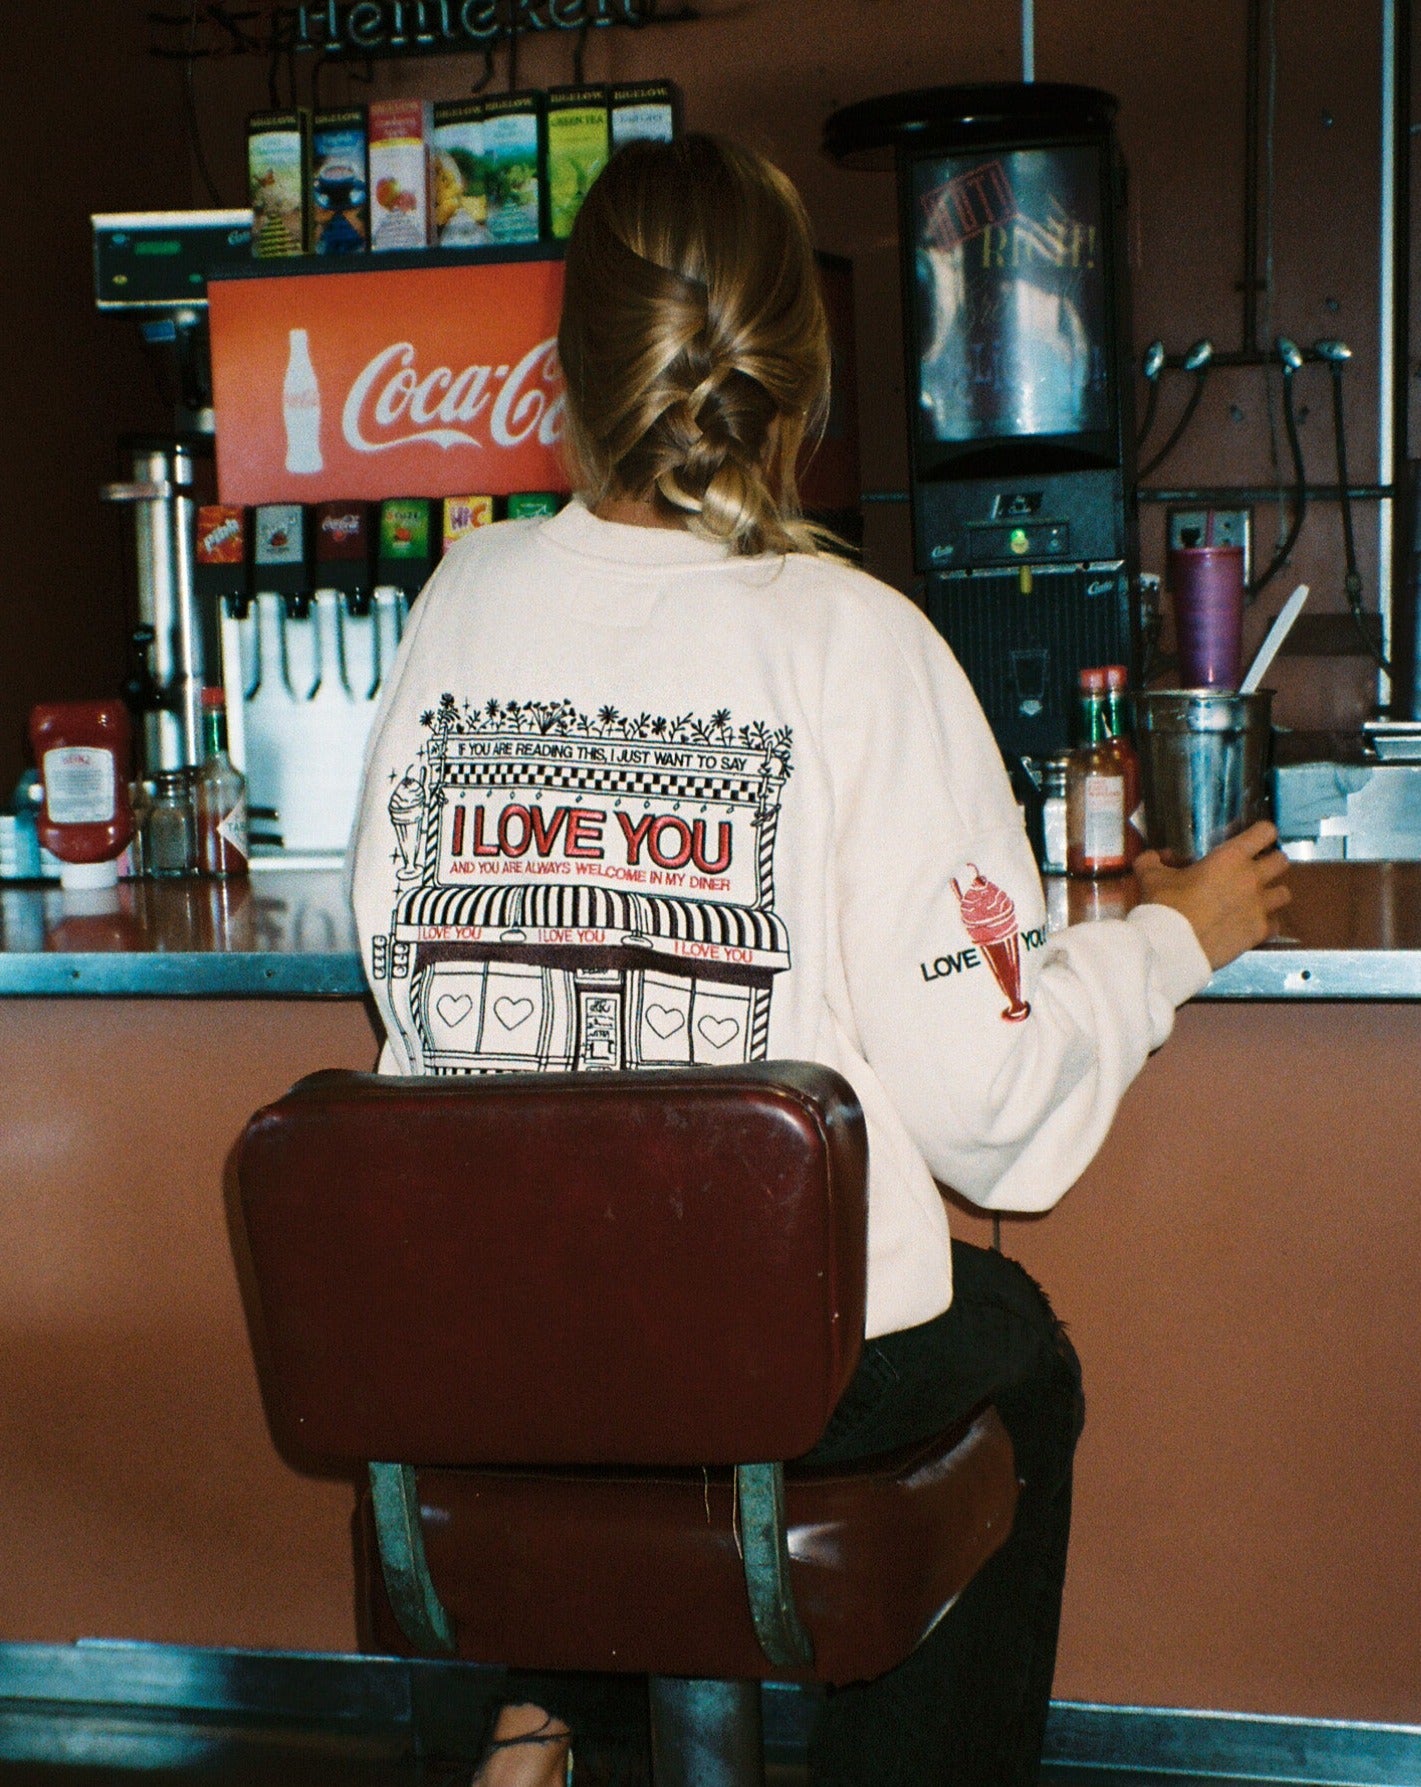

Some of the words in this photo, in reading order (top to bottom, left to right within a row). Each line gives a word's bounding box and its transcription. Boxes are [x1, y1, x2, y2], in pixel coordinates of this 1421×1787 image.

[550, 91, 603, 103] BIGELOW
[614, 87, 668, 100] BIGELOW
[341, 337, 565, 453] Coca-Co
[458, 743, 467, 756] IF
[469, 743, 490, 756] YOU
[493, 743, 512, 755] ARE
[515, 743, 573, 758] READING
[576, 746, 607, 763] THIS,
[617, 749, 650, 764] JUST
[654, 751, 693, 767] WANT
[697, 755, 717, 769] TO
[721, 758, 748, 771] SAY
[451, 804, 466, 857] I
[473, 803, 607, 859] LOVE
[613, 811, 733, 875] YOU
[450, 861, 475, 874] AND
[479, 861, 500, 874] YOU
[502, 861, 523, 874] ARE
[525, 861, 571, 875] ALWAYS
[575, 863, 647, 884] WELCOME
[649, 871, 662, 884] IN
[666, 872, 686, 887] MY
[689, 876, 731, 891] DINER
[423, 926, 453, 940] LOVE
[455, 927, 482, 940] YOU
[544, 929, 573, 942] LOVE
[577, 930, 606, 943] YOU
[682, 942, 720, 959] LOVE
[724, 947, 753, 963] YOU
[921, 948, 981, 981] LOVE
